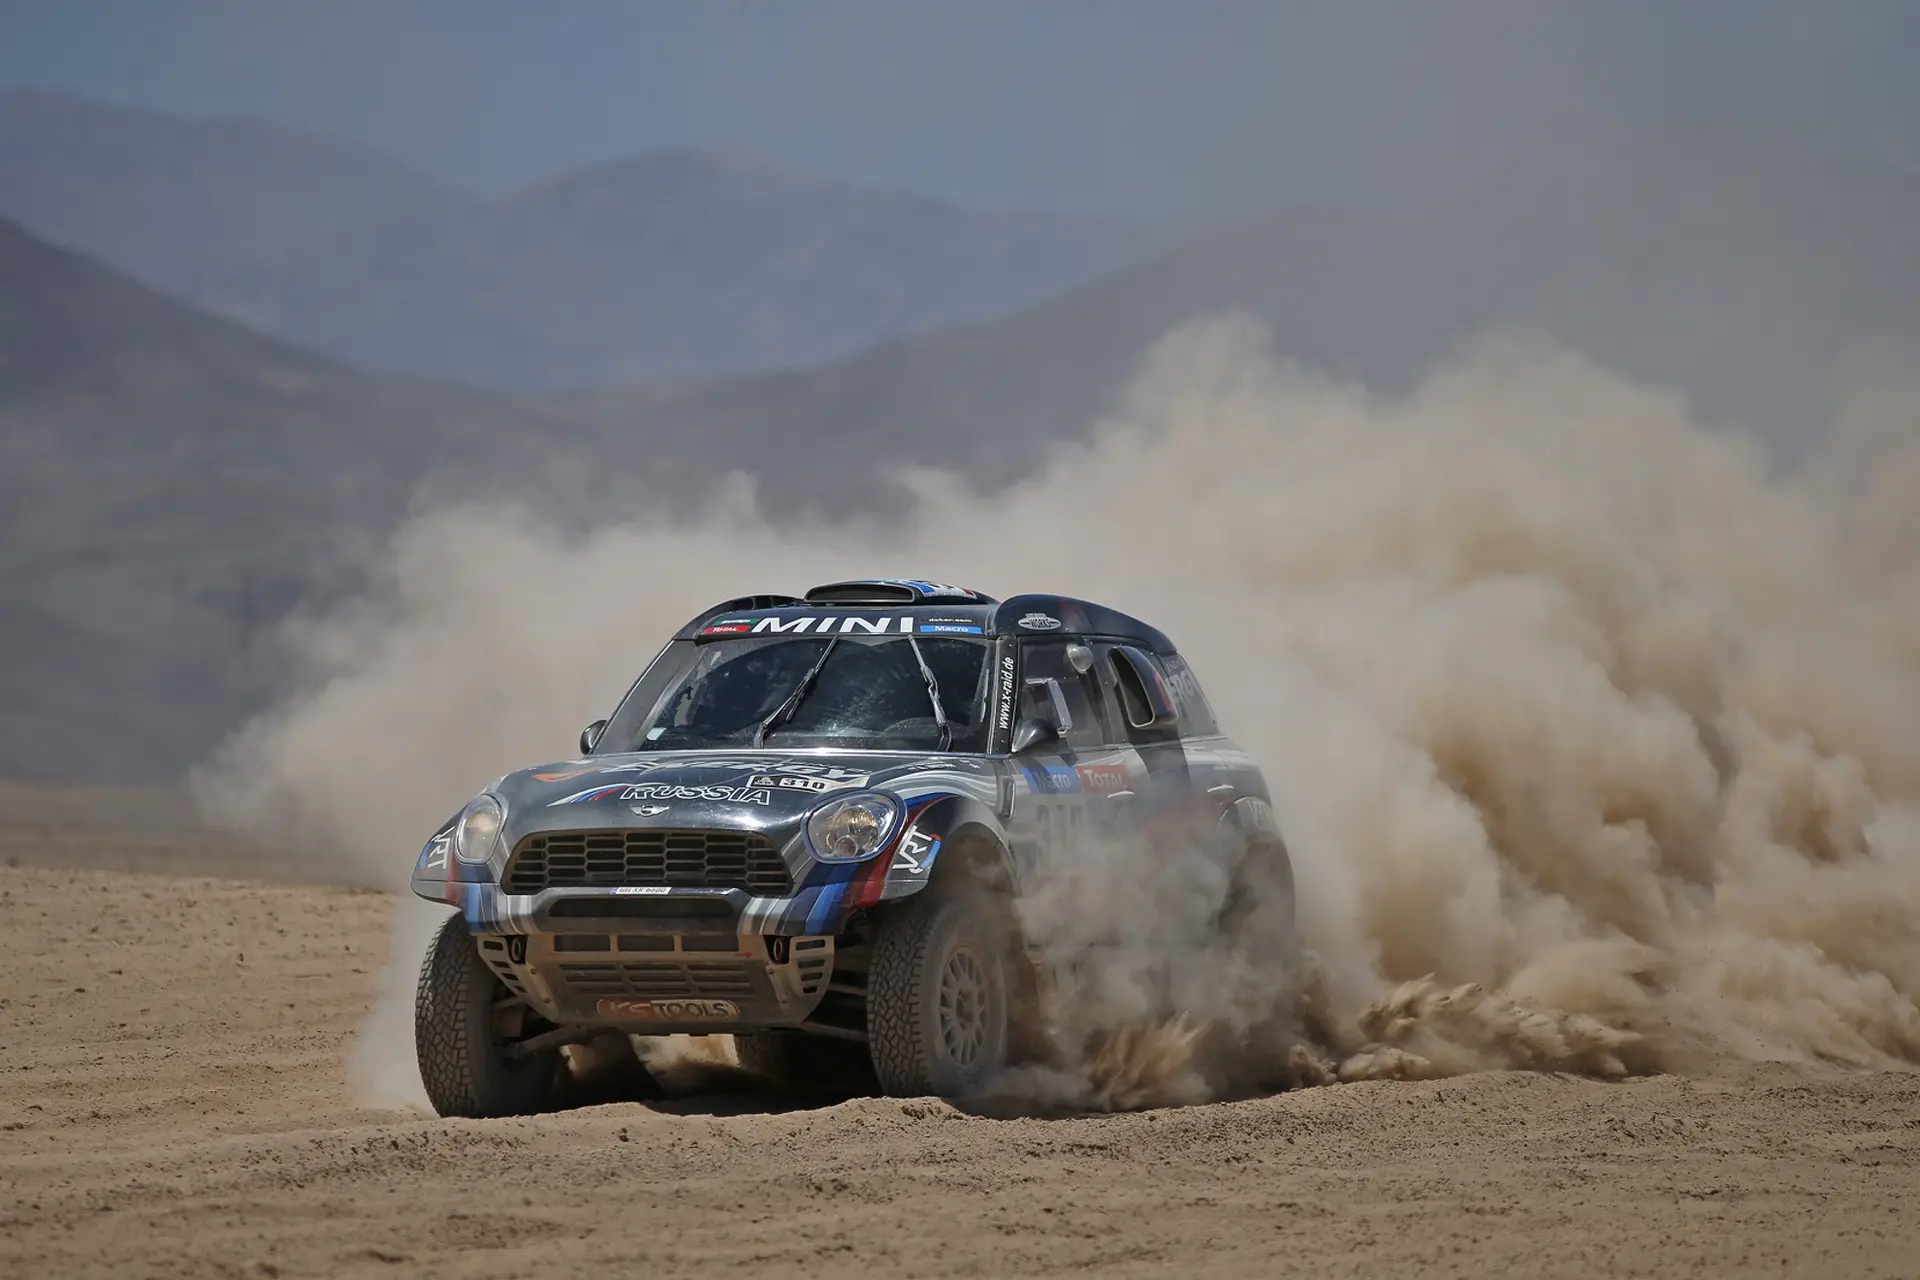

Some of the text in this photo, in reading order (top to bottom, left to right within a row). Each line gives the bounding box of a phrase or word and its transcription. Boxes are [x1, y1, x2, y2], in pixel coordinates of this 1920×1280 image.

[751, 617, 914, 633] MINI
[999, 656, 1014, 730] www.x-raid.de
[783, 780, 826, 790] 310
[1034, 771, 1071, 789] Macro
[620, 785, 771, 806] RUSSIA
[892, 824, 933, 870] VRT
[650, 1001, 729, 1018] TOOLS
